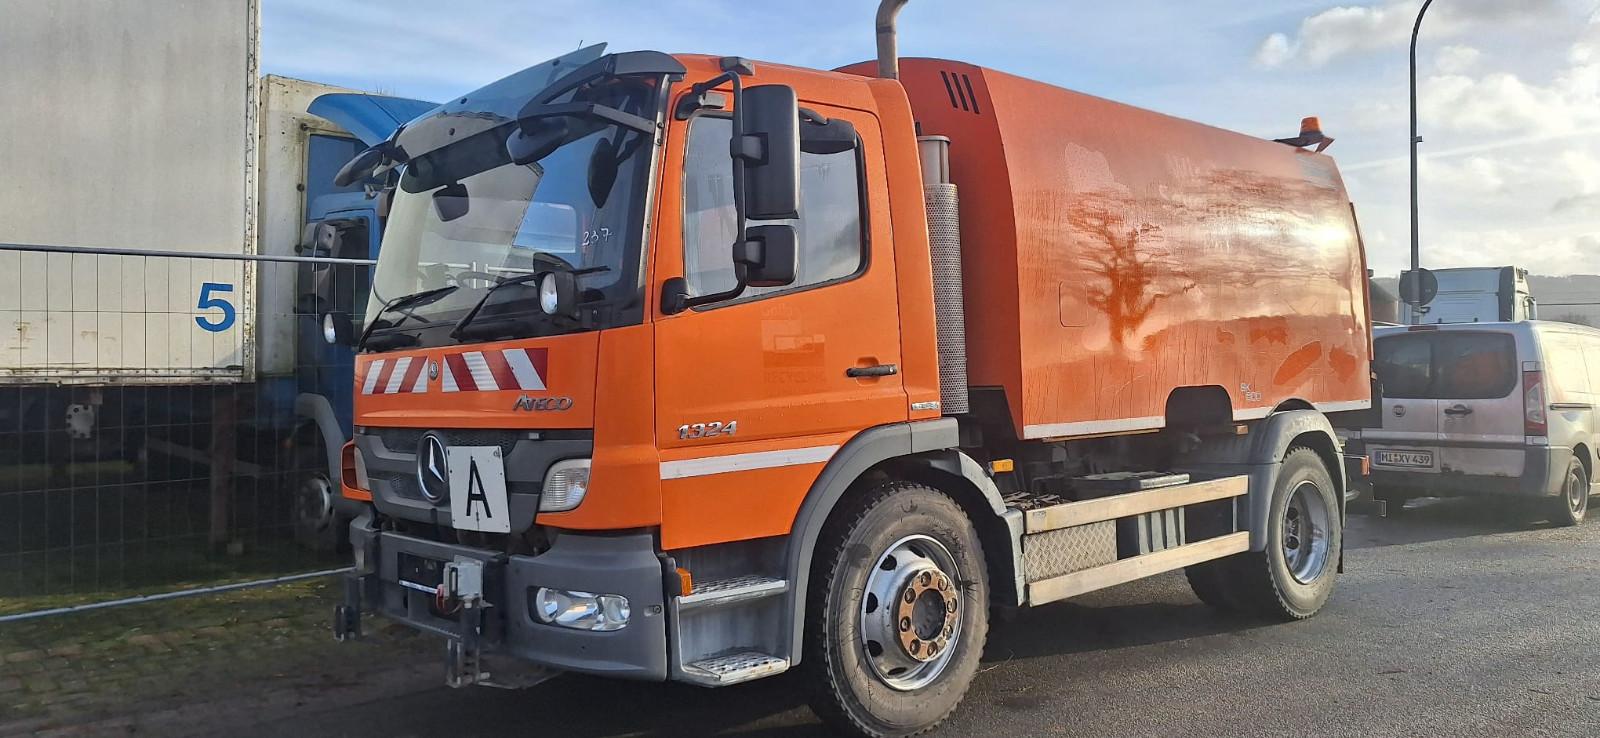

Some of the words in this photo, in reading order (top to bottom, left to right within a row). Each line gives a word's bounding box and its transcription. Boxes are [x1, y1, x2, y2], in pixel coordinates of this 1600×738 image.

[195, 282, 236, 332] 5
[512, 393, 573, 411] ATECO
[677, 420, 737, 440] 1324
[466, 456, 492, 518] A
